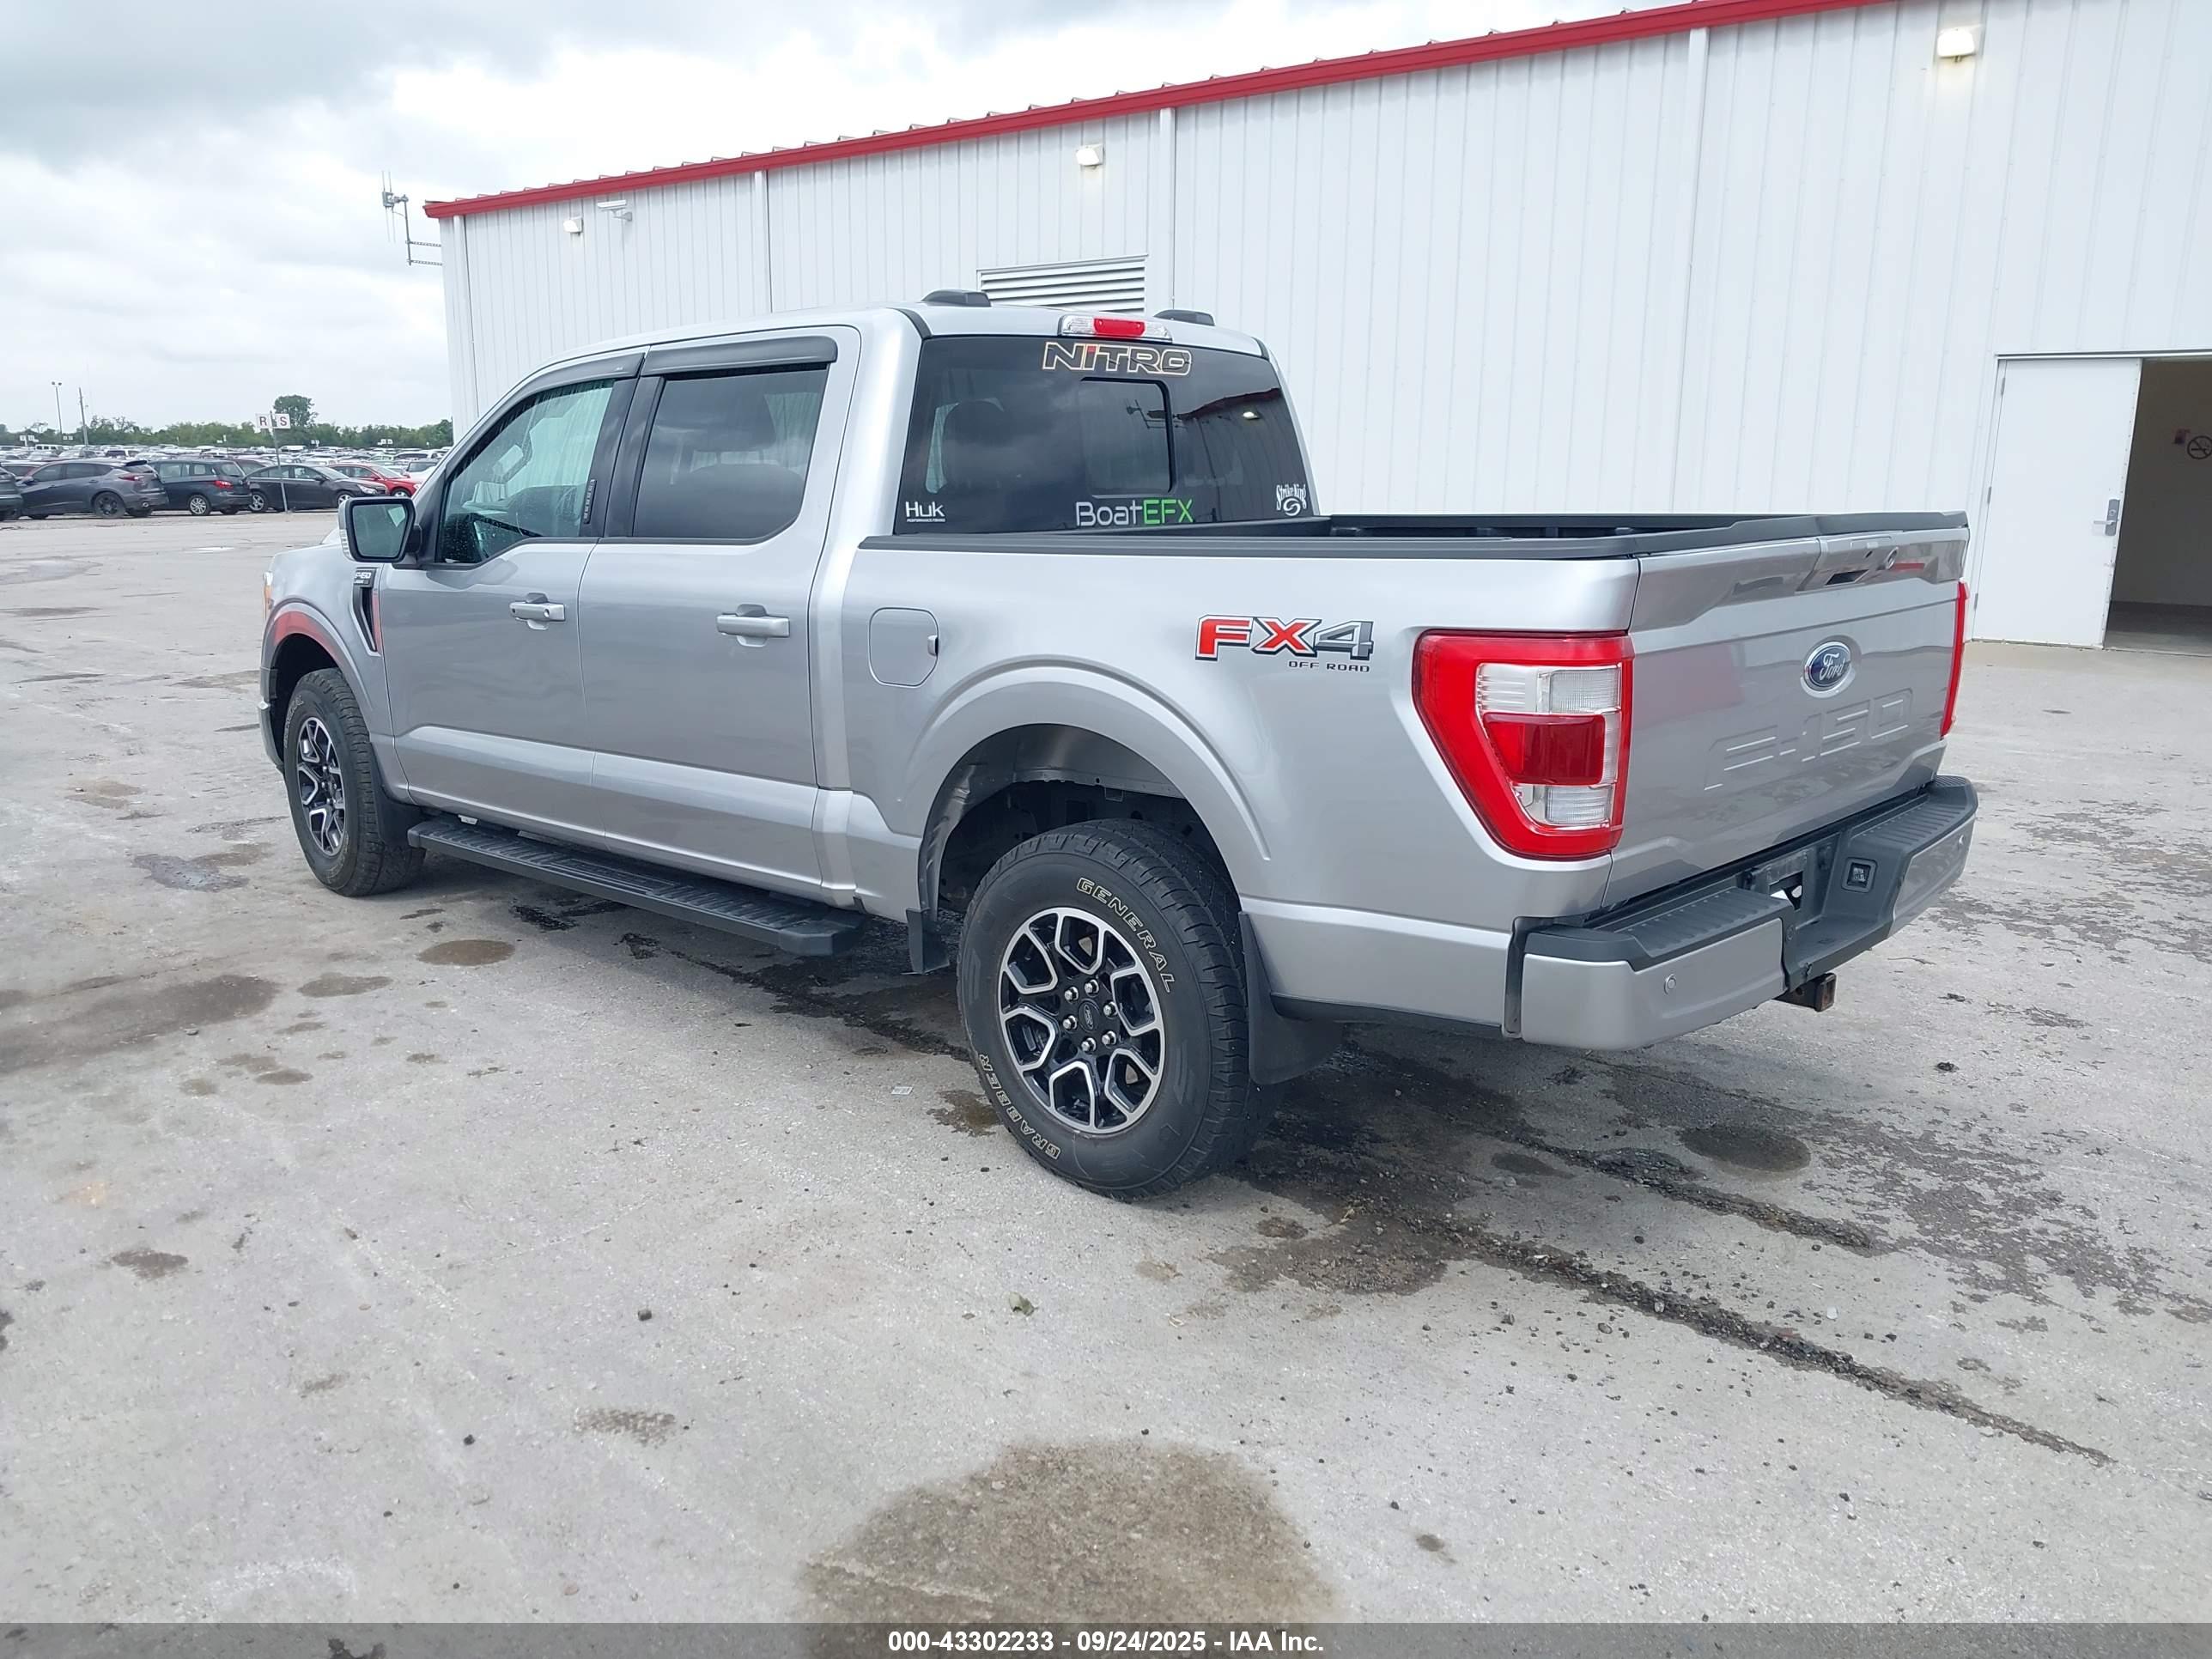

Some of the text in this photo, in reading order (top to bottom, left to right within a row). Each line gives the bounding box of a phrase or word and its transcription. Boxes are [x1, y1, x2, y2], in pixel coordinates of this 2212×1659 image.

[259, 416, 267, 426] R
[280, 416, 288, 426] S
[1076, 499, 1194, 526] BoatEFX
[1195, 614, 1374, 661] FX4
[1327, 662, 1370, 673] ROAD
[1820, 653, 1845, 681] Ford
[1076, 877, 1175, 994] GENERAL
[979, 1054, 1061, 1160] GRABBER
